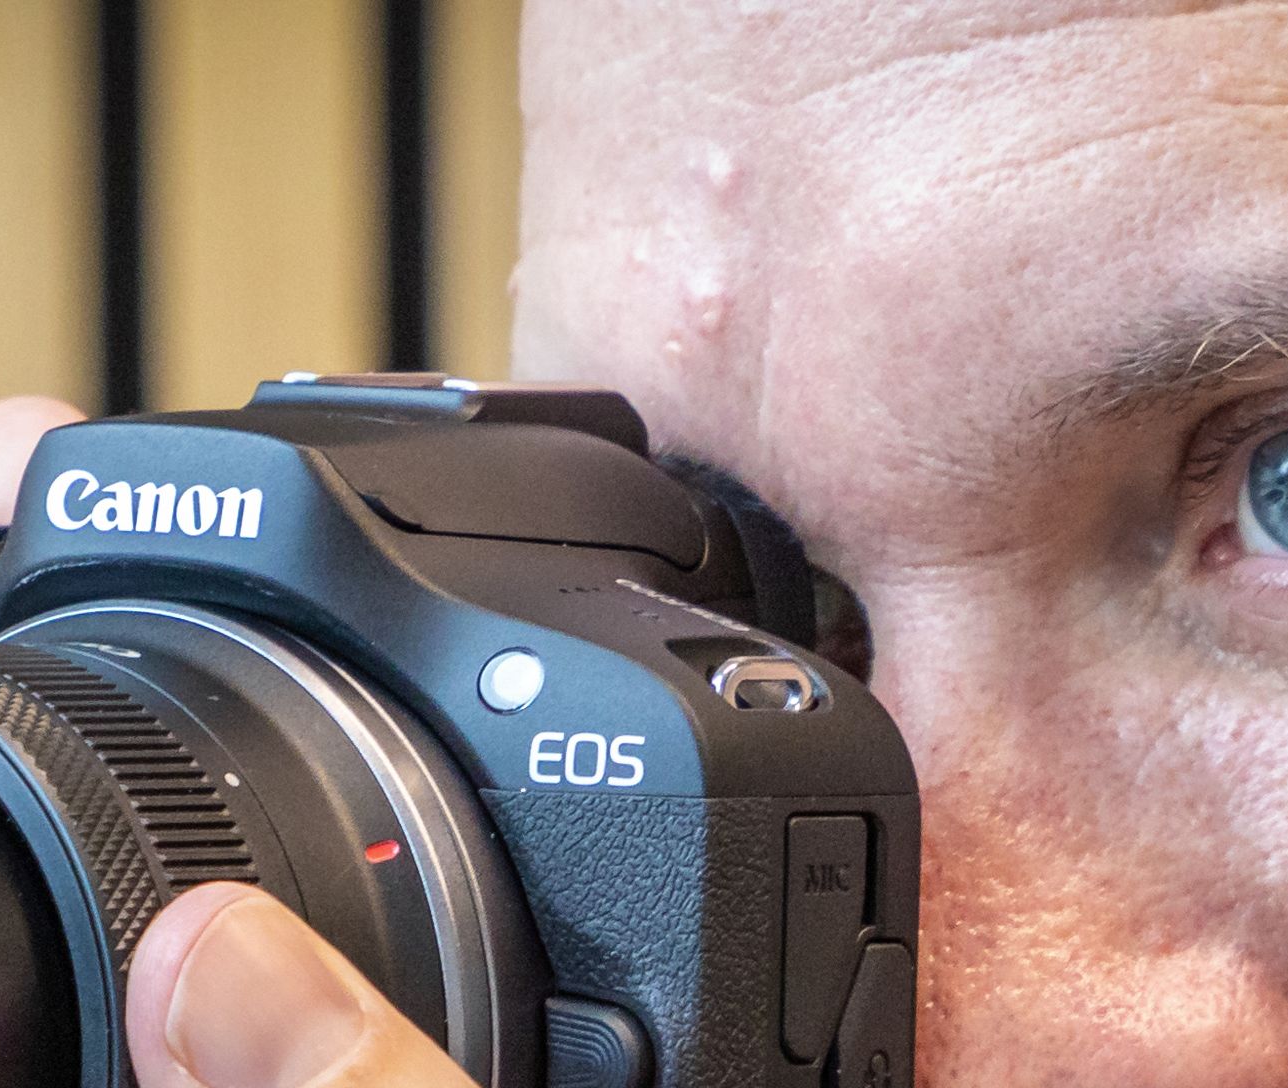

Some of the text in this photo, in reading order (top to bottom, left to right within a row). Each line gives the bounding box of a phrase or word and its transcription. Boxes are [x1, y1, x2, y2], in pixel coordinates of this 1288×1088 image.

[46, 469, 263, 539] Canon
[529, 731, 646, 787] EOS
[805, 862, 851, 894] MIC
